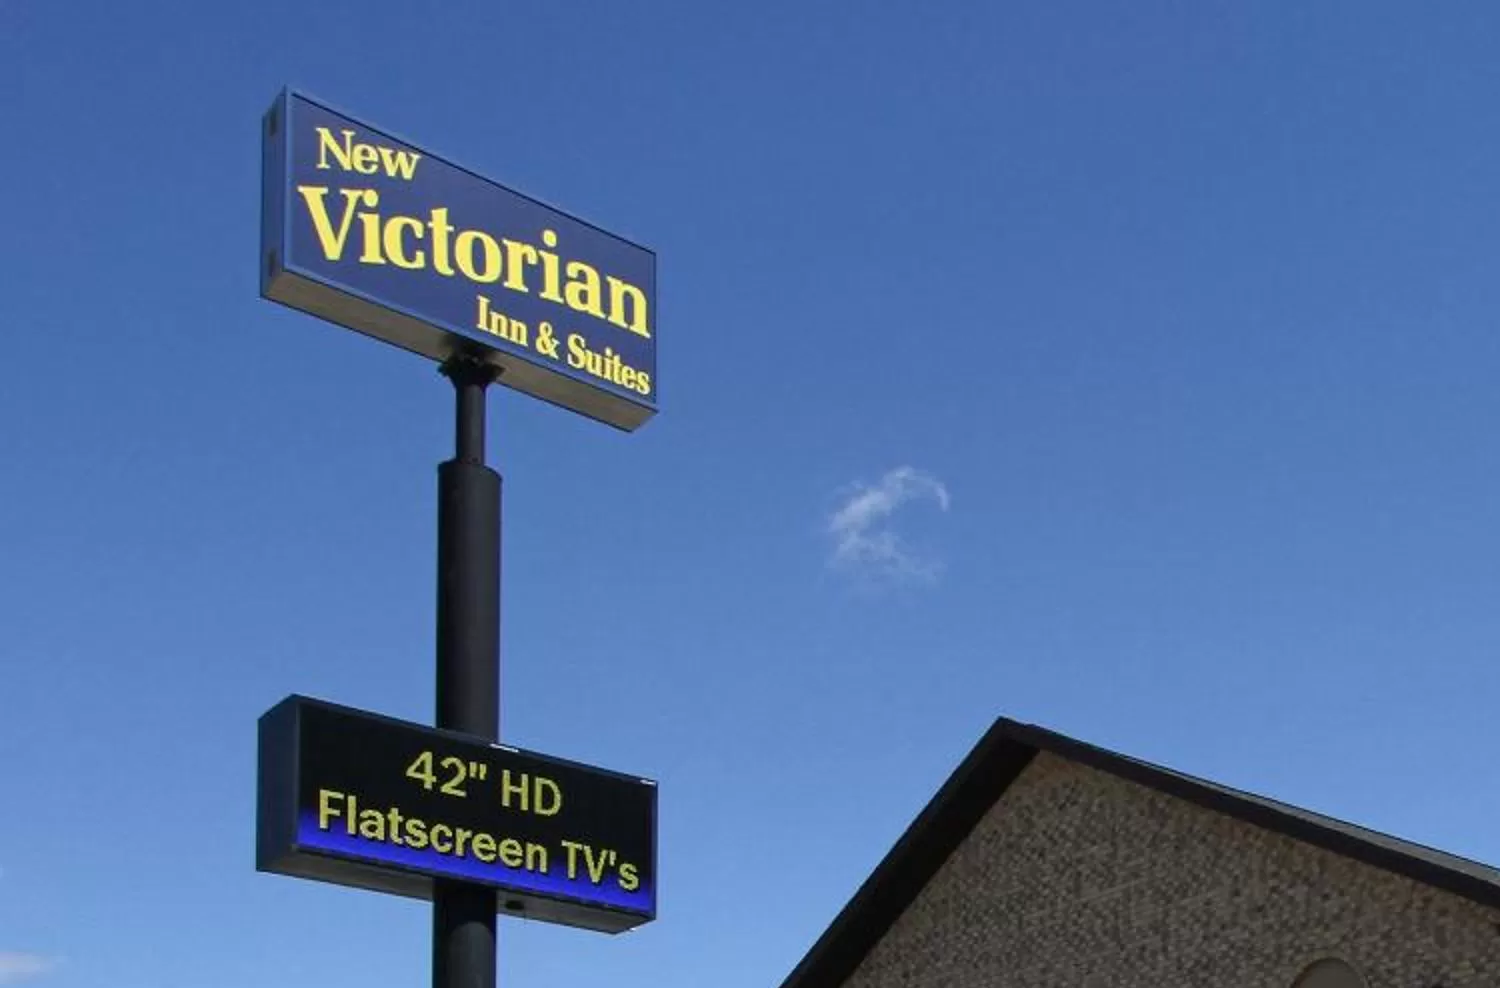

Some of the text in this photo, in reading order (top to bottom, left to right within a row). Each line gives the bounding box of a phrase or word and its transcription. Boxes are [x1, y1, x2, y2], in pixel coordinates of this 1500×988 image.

[315, 127, 421, 181] New
[298, 185, 651, 339] Victorian
[475, 294, 651, 396] Inn & Suites
[406, 750, 562, 817] 42" HD
[318, 788, 640, 892] Flatscreen TV's
